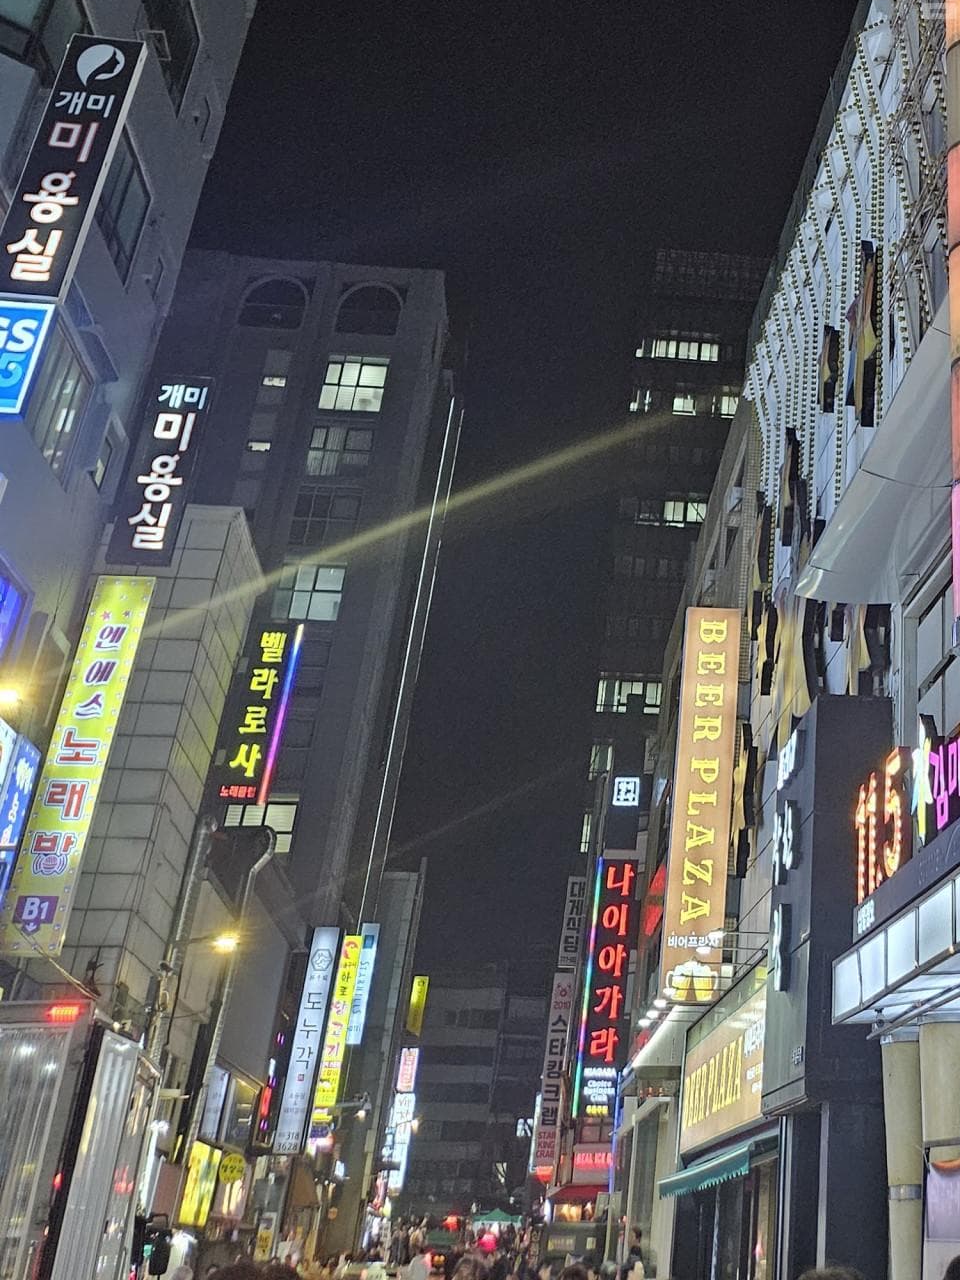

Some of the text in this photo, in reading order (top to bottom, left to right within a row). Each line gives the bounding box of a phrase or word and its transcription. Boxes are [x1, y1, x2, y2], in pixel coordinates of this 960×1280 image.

[55, 91, 115, 118] 개미
[6, 121, 99, 283] 미용실
[158, 384, 208, 409] 개미
[128, 412, 197, 550] 미용실
[76, 624, 127, 718] 엔에스
[229, 631, 287, 778] 벨라로사
[680, 618, 728, 926] BEER PLAZA
[855, 748, 902, 906] 11.5
[23, 897, 49, 920] B1
[563, 881, 586, 954] 대게식당
[590, 863, 634, 1063] 나이아가라
[296, 991, 323, 1070] 도누각
[541, 1015, 568, 1126] 스타킹크랩
[683, 1061, 708, 1131] BEER
[705, 1035, 743, 1118] PLAZA
